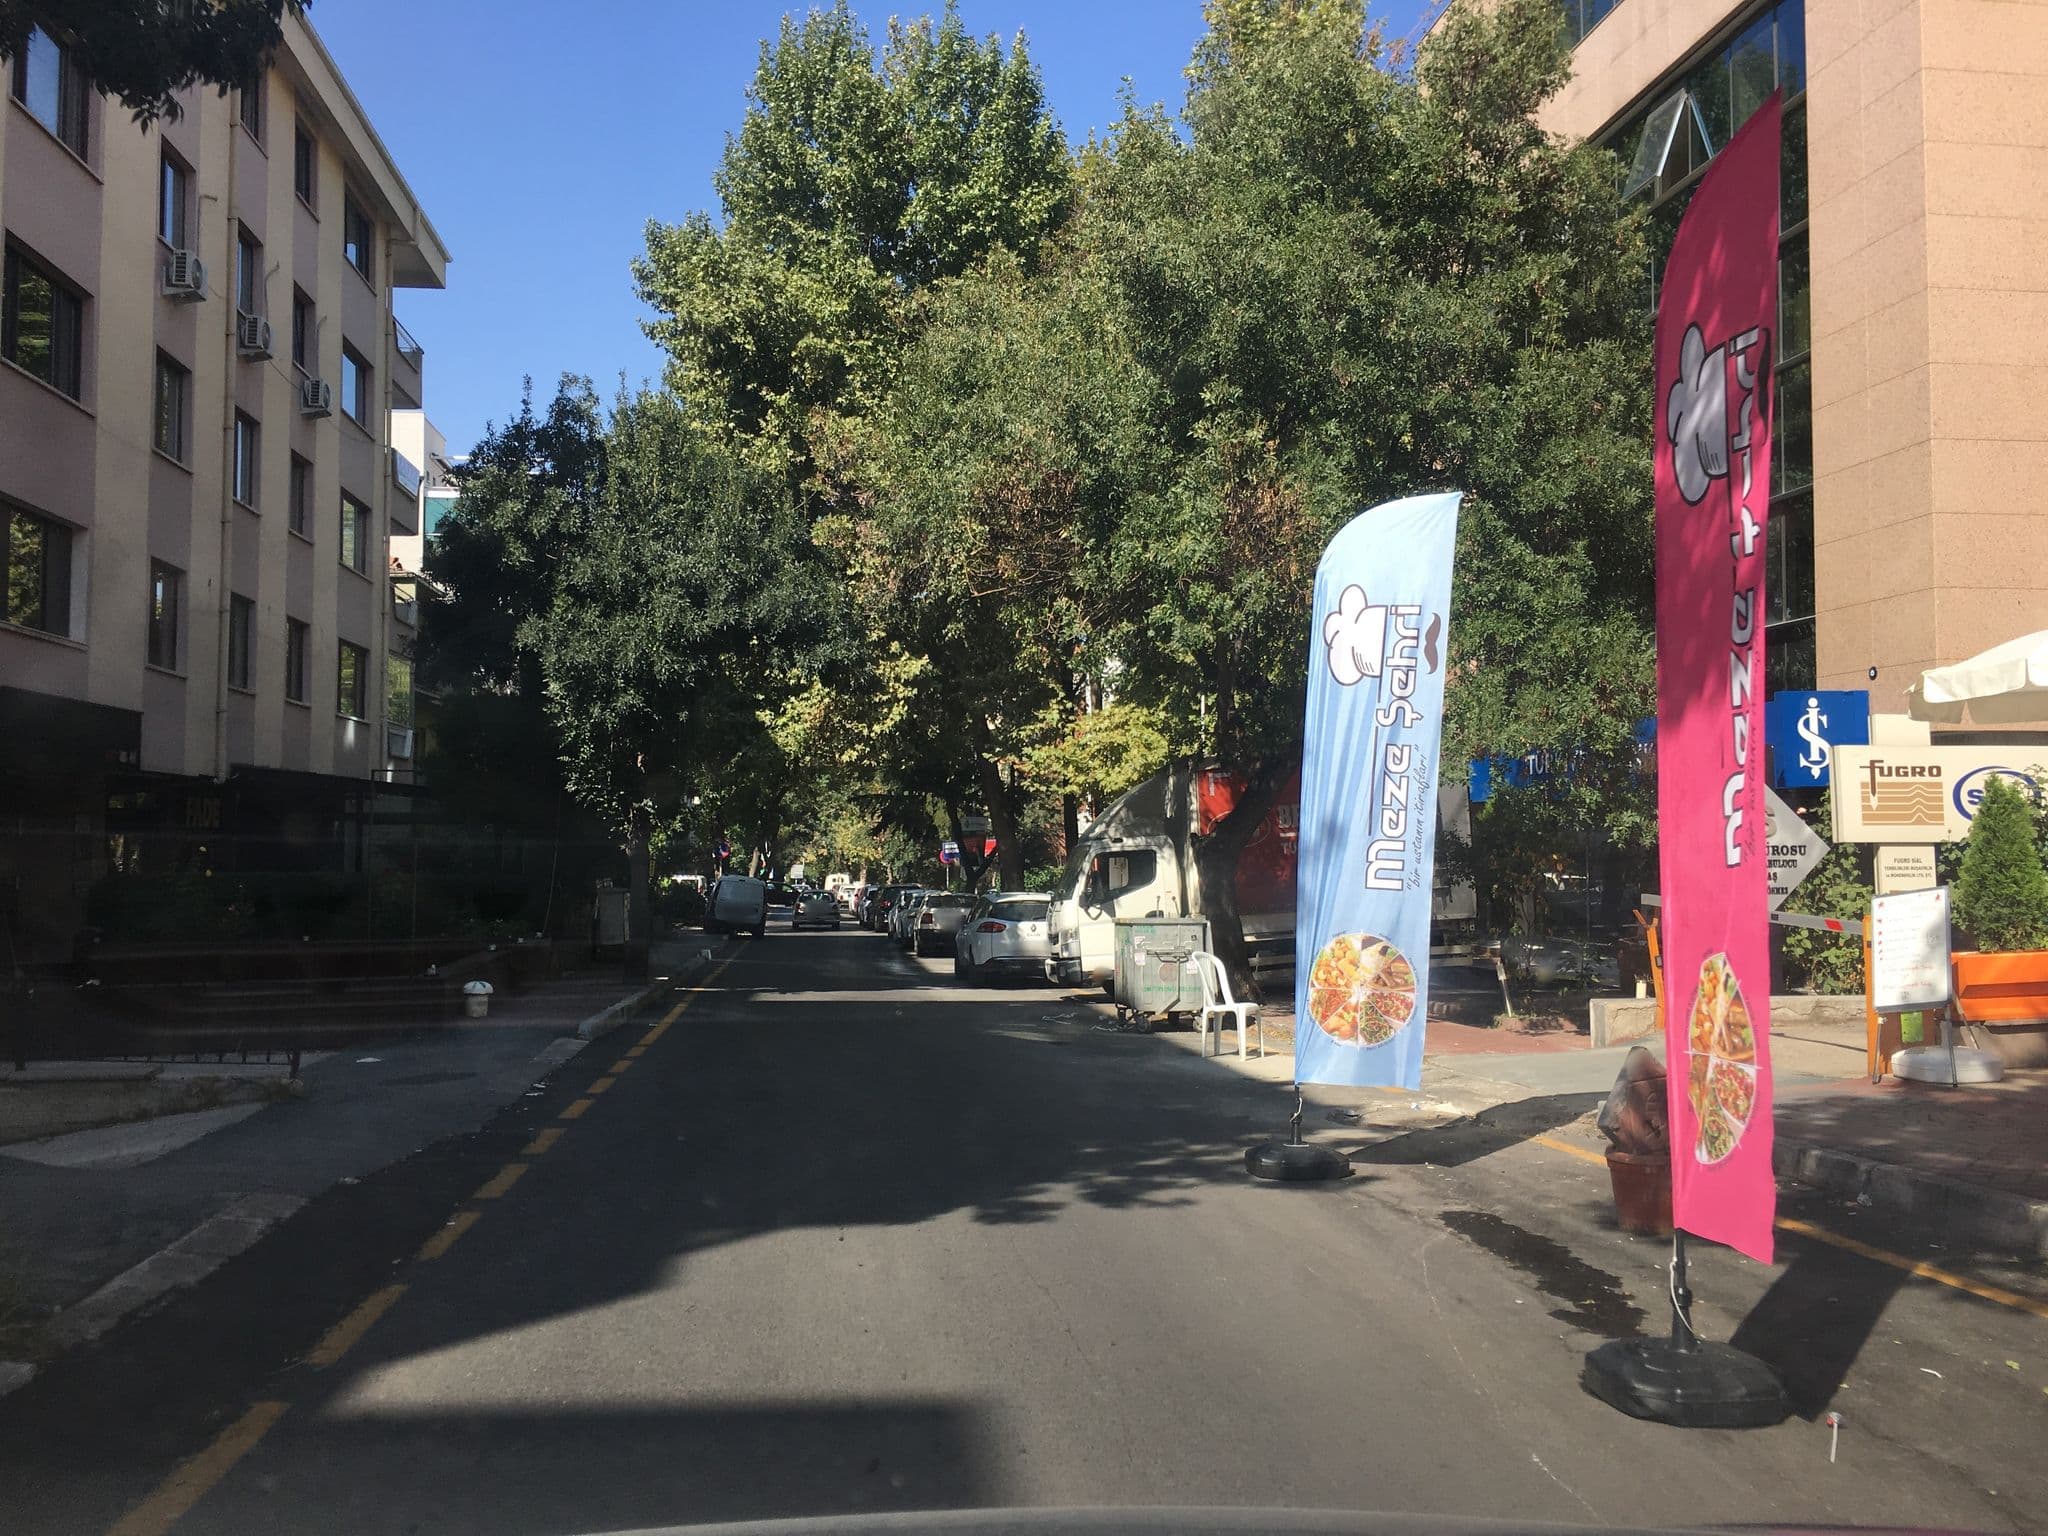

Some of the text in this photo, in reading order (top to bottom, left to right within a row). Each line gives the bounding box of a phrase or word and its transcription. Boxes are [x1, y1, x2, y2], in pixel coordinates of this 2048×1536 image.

[1365, 605, 1424, 891] Meze Şehri
[1412, 818, 1425, 864] ustanın
[1766, 842, 1807, 857] ROSU
